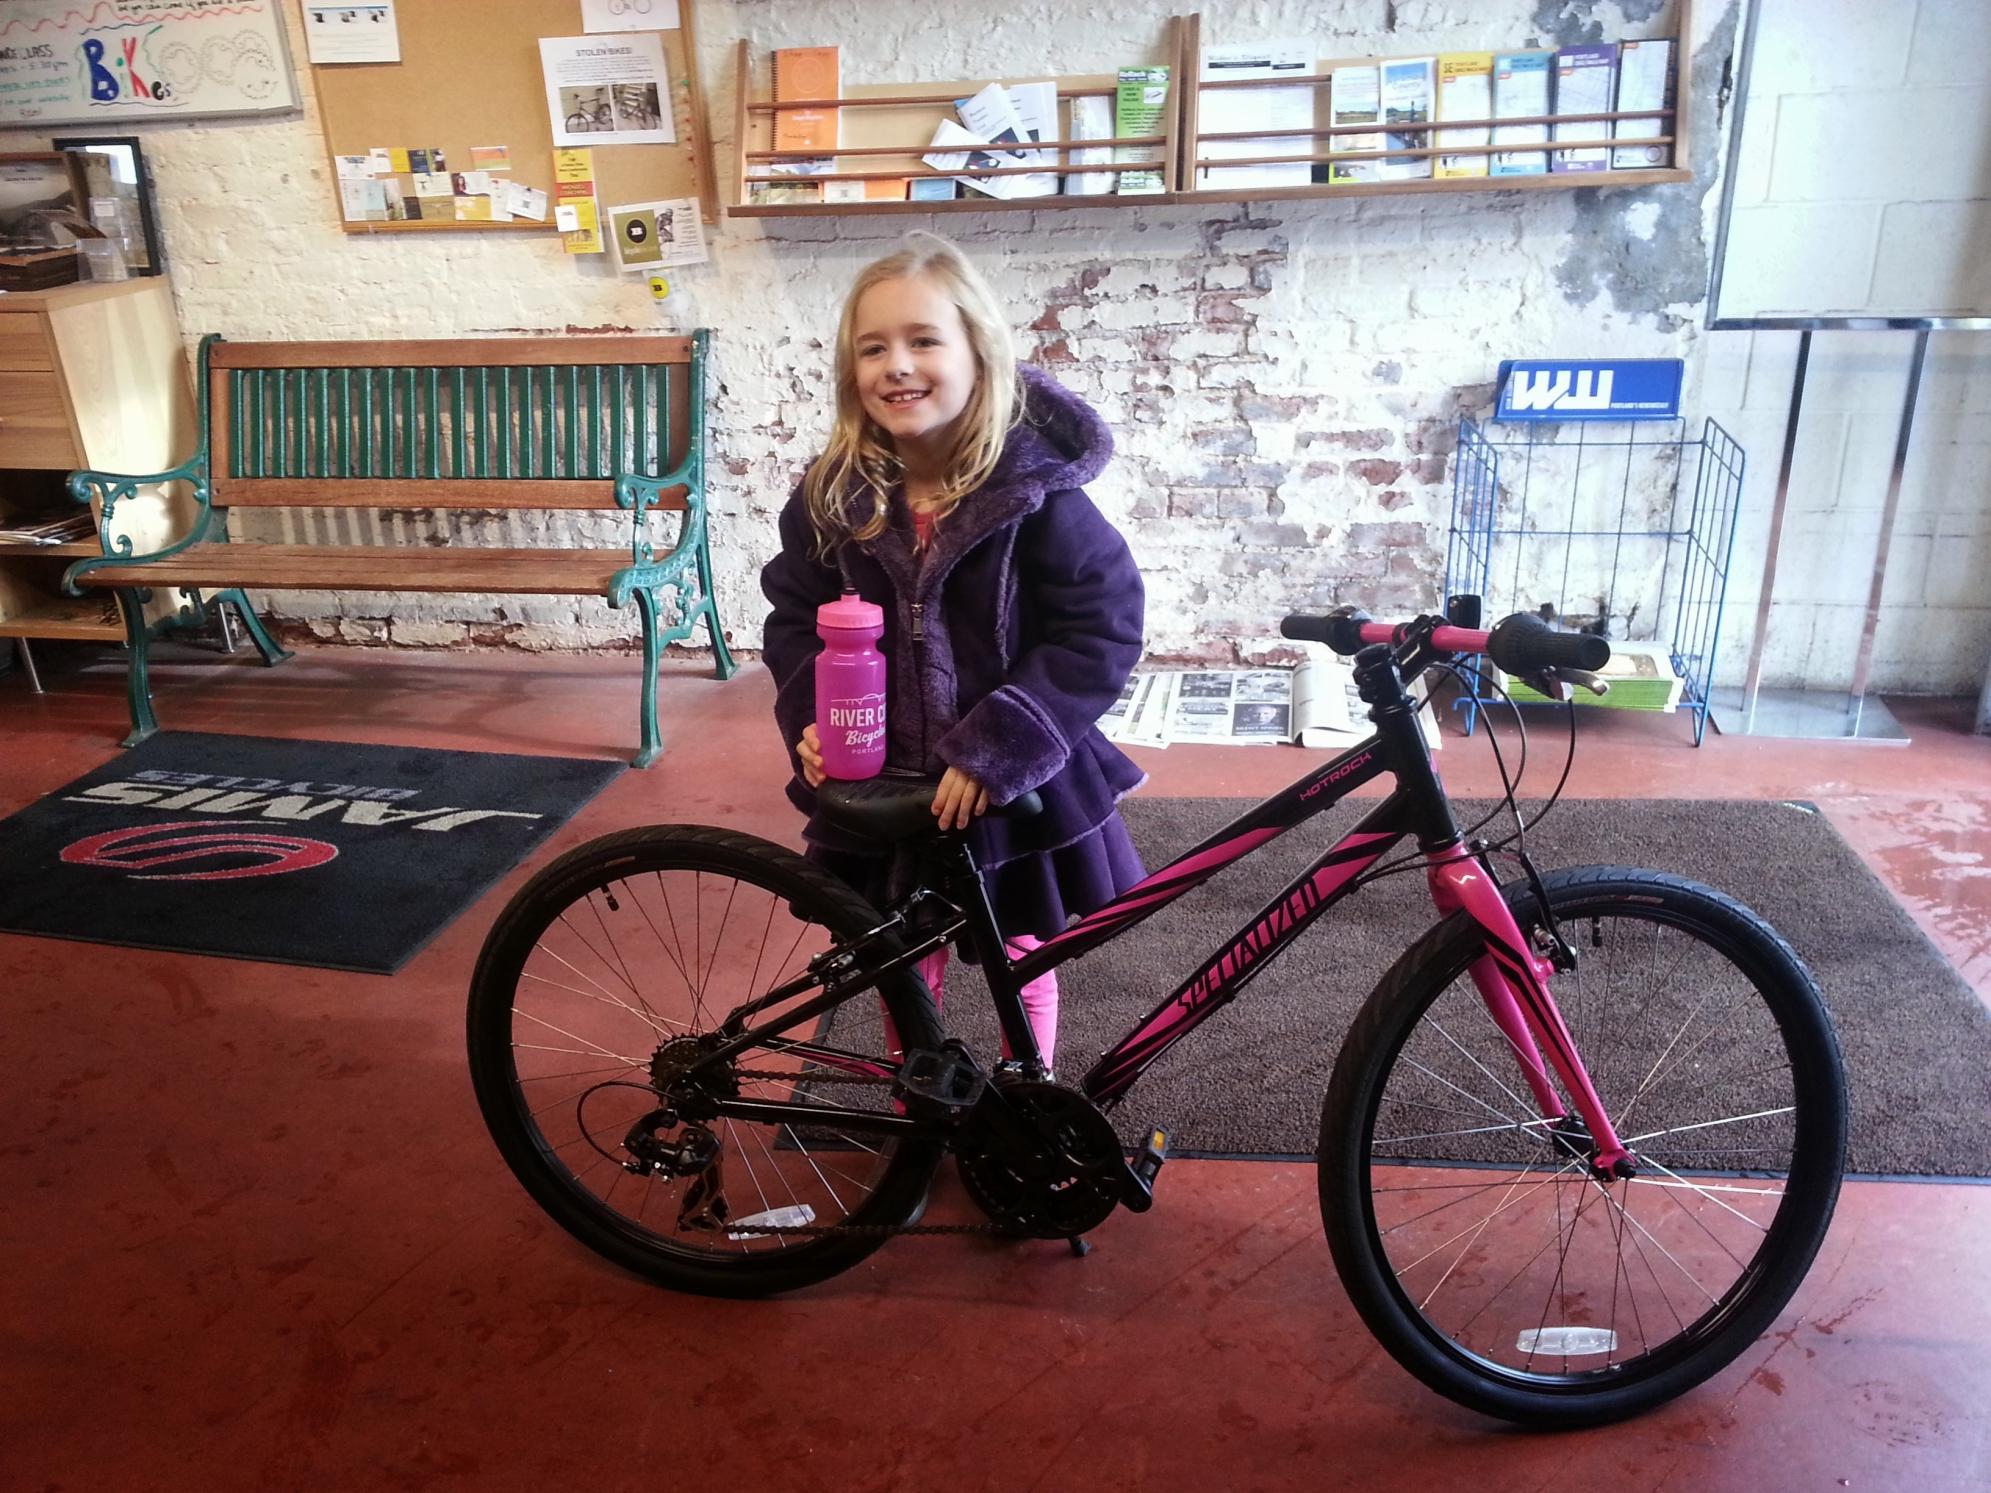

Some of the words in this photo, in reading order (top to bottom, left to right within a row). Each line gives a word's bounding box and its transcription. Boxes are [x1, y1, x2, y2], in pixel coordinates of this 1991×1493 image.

[575, 48, 607, 57] STOLEN
[830, 707, 875, 728] RIVER
[125, 769, 422, 801] BICYCLES
[1299, 752, 1373, 802] HOTROCK
[63, 781, 543, 832] JAMIS
[1177, 877, 1321, 1015] SPECIALIZED
